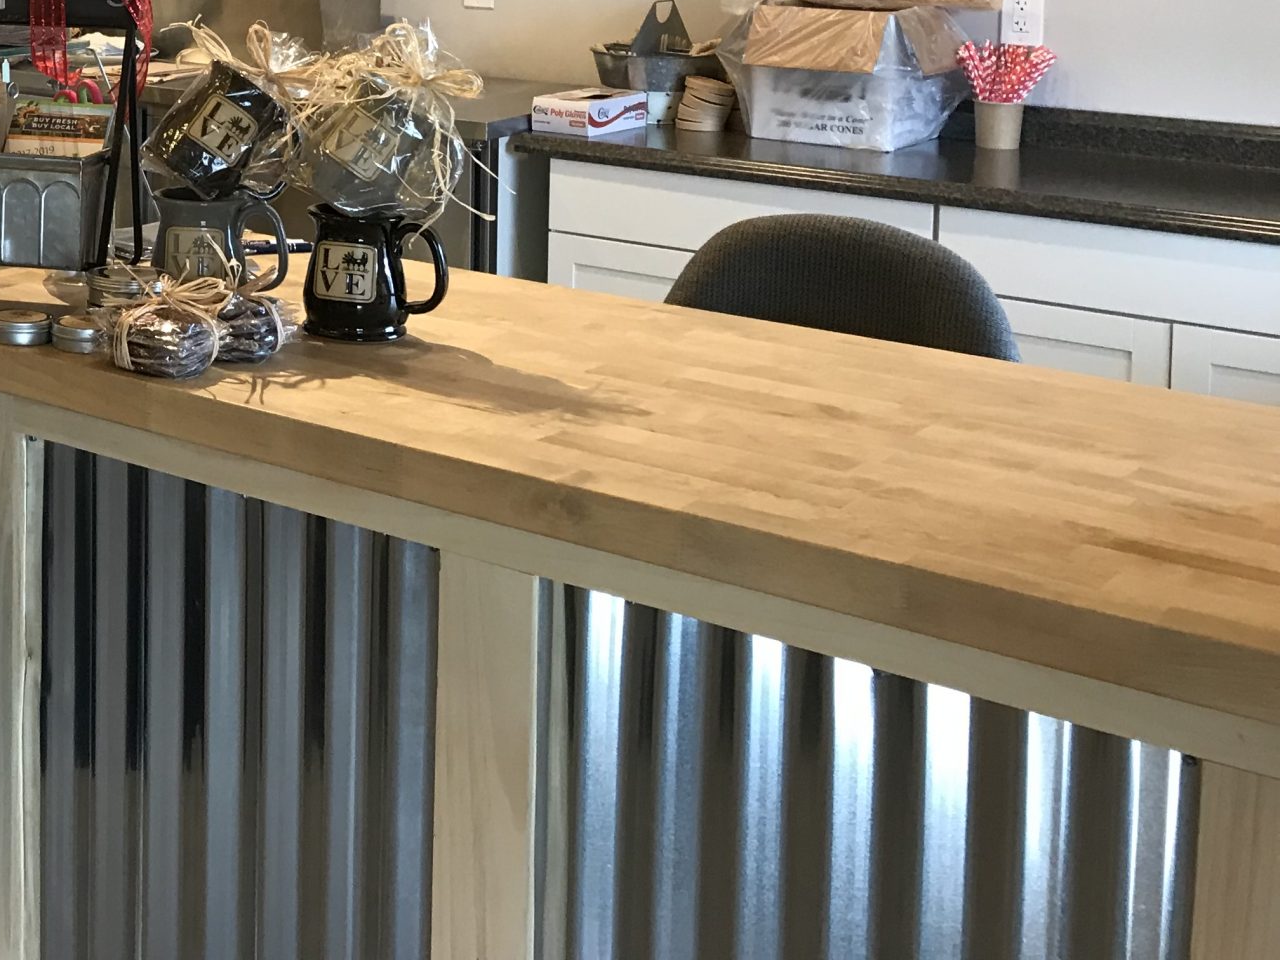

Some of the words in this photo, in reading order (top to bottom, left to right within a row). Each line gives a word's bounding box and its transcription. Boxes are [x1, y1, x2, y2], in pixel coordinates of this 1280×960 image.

[550, 107, 564, 118] Poly
[51, 117, 78, 125] FRESH
[50, 123, 76, 131] LOCAL
[829, 124, 864, 135] CONES
[322, 247, 340, 270] L
